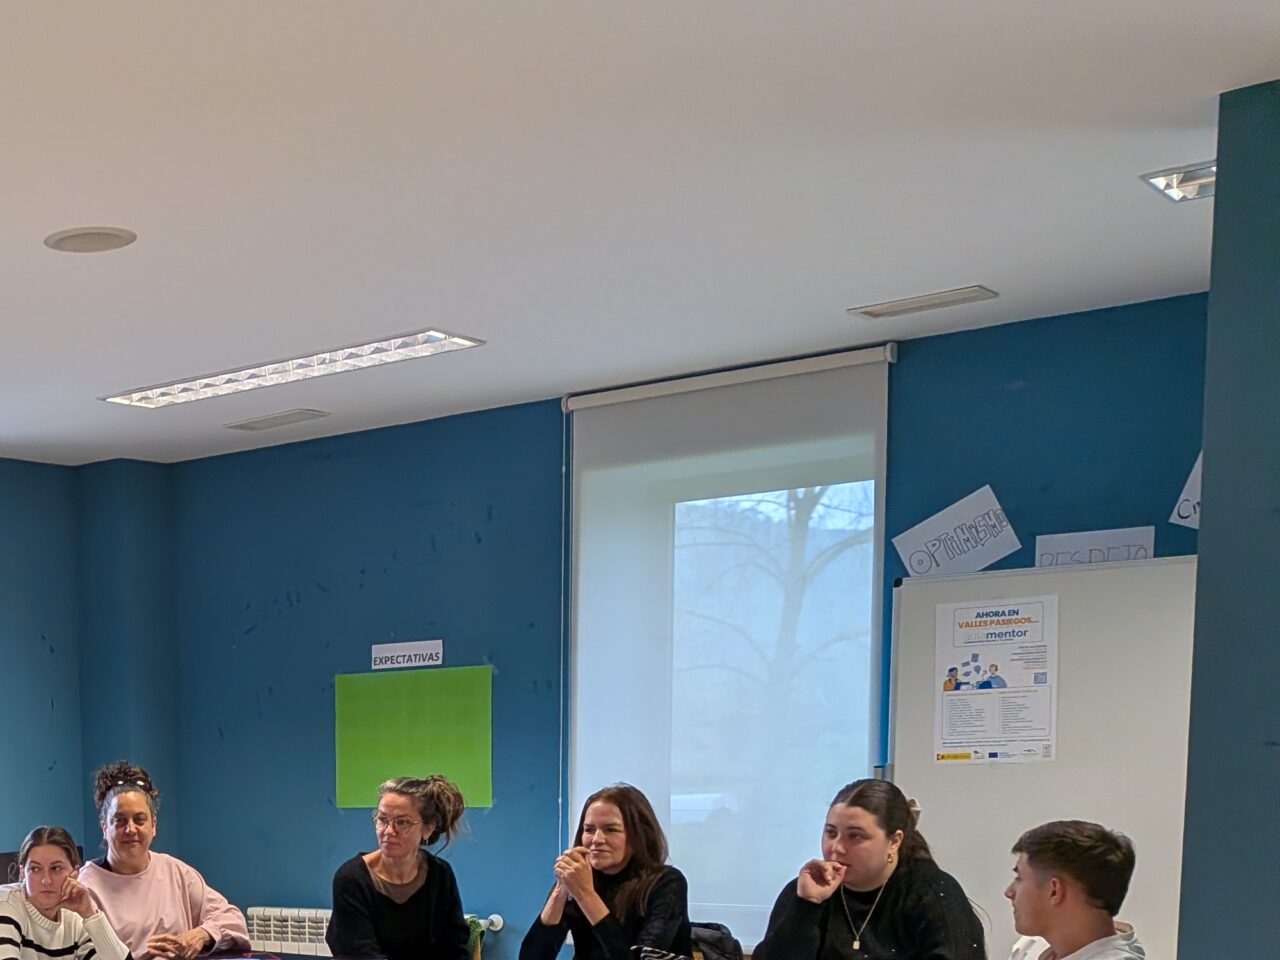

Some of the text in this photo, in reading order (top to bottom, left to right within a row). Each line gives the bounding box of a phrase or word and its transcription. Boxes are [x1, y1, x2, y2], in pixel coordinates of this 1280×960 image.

[974, 608, 1019, 619] AHORA EN
[958, 619, 988, 629] VALLES
[373, 651, 440, 666] EXPECTATIVAS
